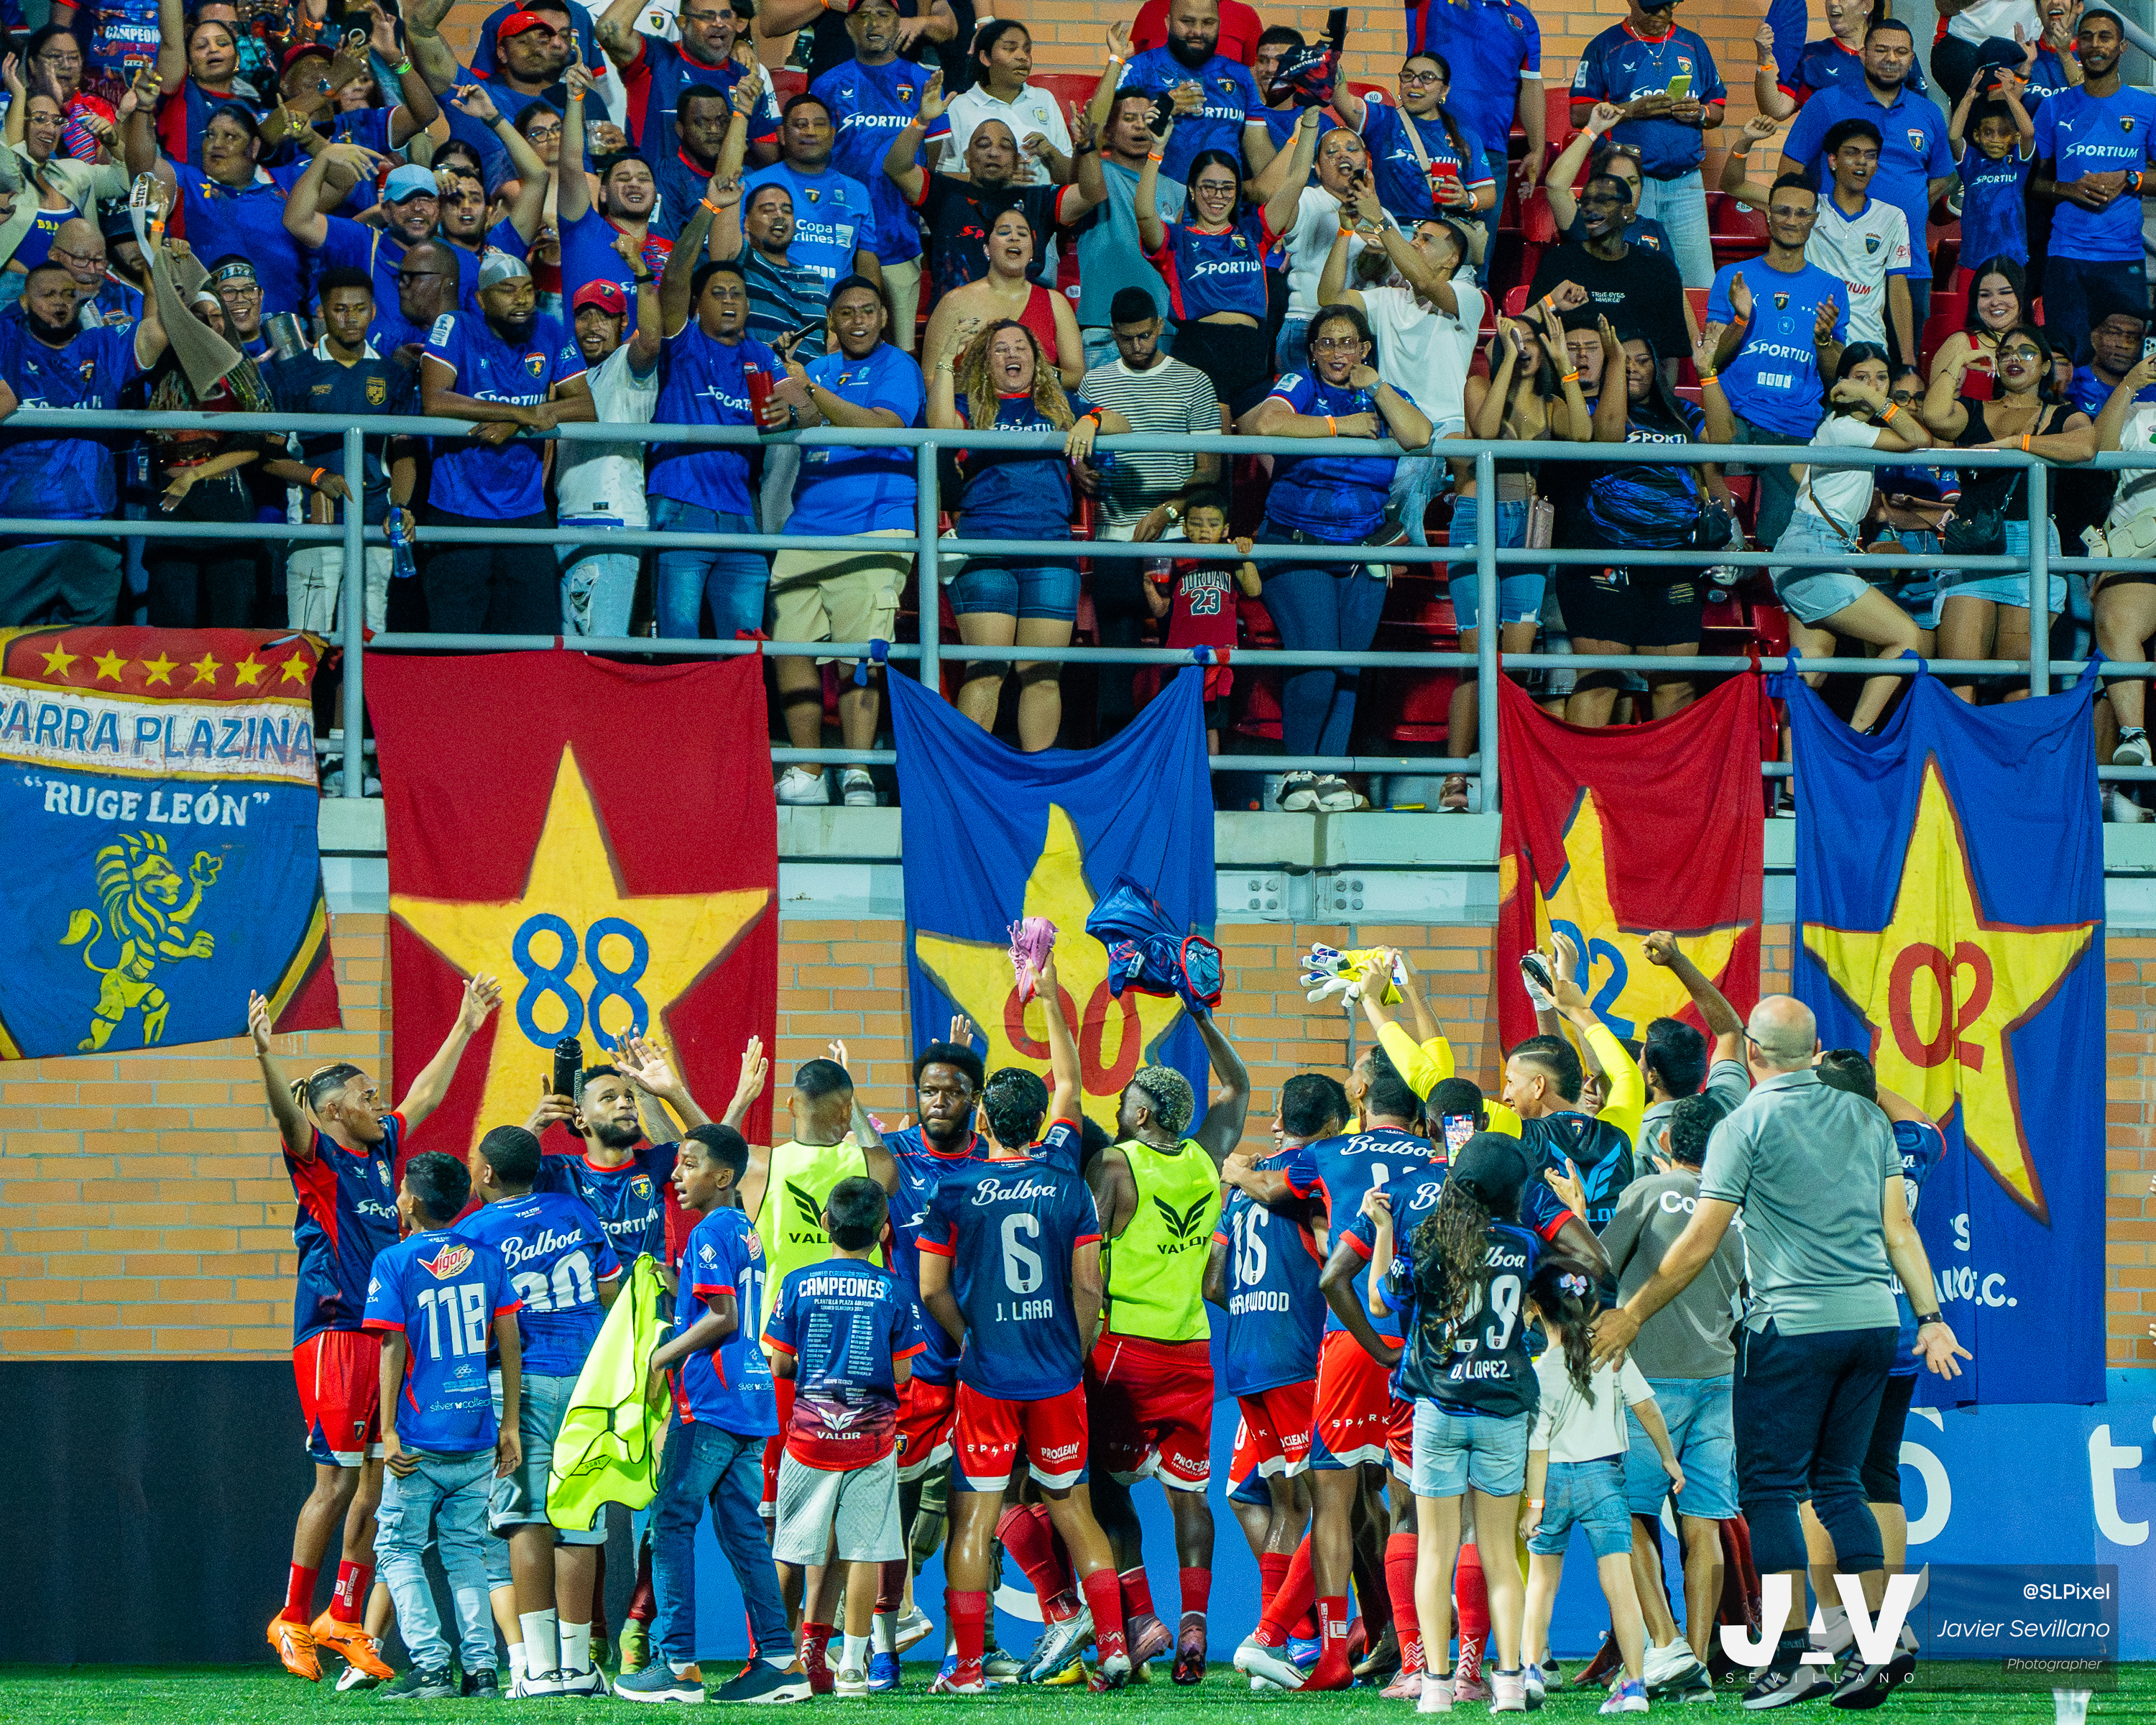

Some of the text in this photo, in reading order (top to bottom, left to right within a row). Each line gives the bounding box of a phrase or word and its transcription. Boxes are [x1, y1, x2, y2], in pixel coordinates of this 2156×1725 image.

[838, 111, 911, 133] SPORTIU
[2063, 142, 2140, 160] SPORTIUM
[793, 231, 834, 244] rlines
[796, 218, 833, 234] Copa
[1190, 588, 1221, 615] 23
[0, 699, 314, 764] ARRA PLAZINA
[512, 913, 648, 1052] 88
[1888, 942, 1994, 1074] 02
[972, 1178, 1057, 1206] Balboa
[500, 1228, 581, 1270] Balboa
[788, 1232, 832, 1244] VAL
[1233, 1202, 1270, 1290] 16
[1000, 1213, 1043, 1294] 6
[1486, 1246, 1526, 1268] lboa
[798, 1276, 885, 1299] CAMPEONES
[417, 1282, 487, 1360] 118
[996, 1299, 1053, 1322] J. LARA
[1465, 1360, 1511, 1379] LOPEZ
[816, 1430, 861, 1440] VALOR
[1041, 1440, 1080, 1460] PROCLEAN
